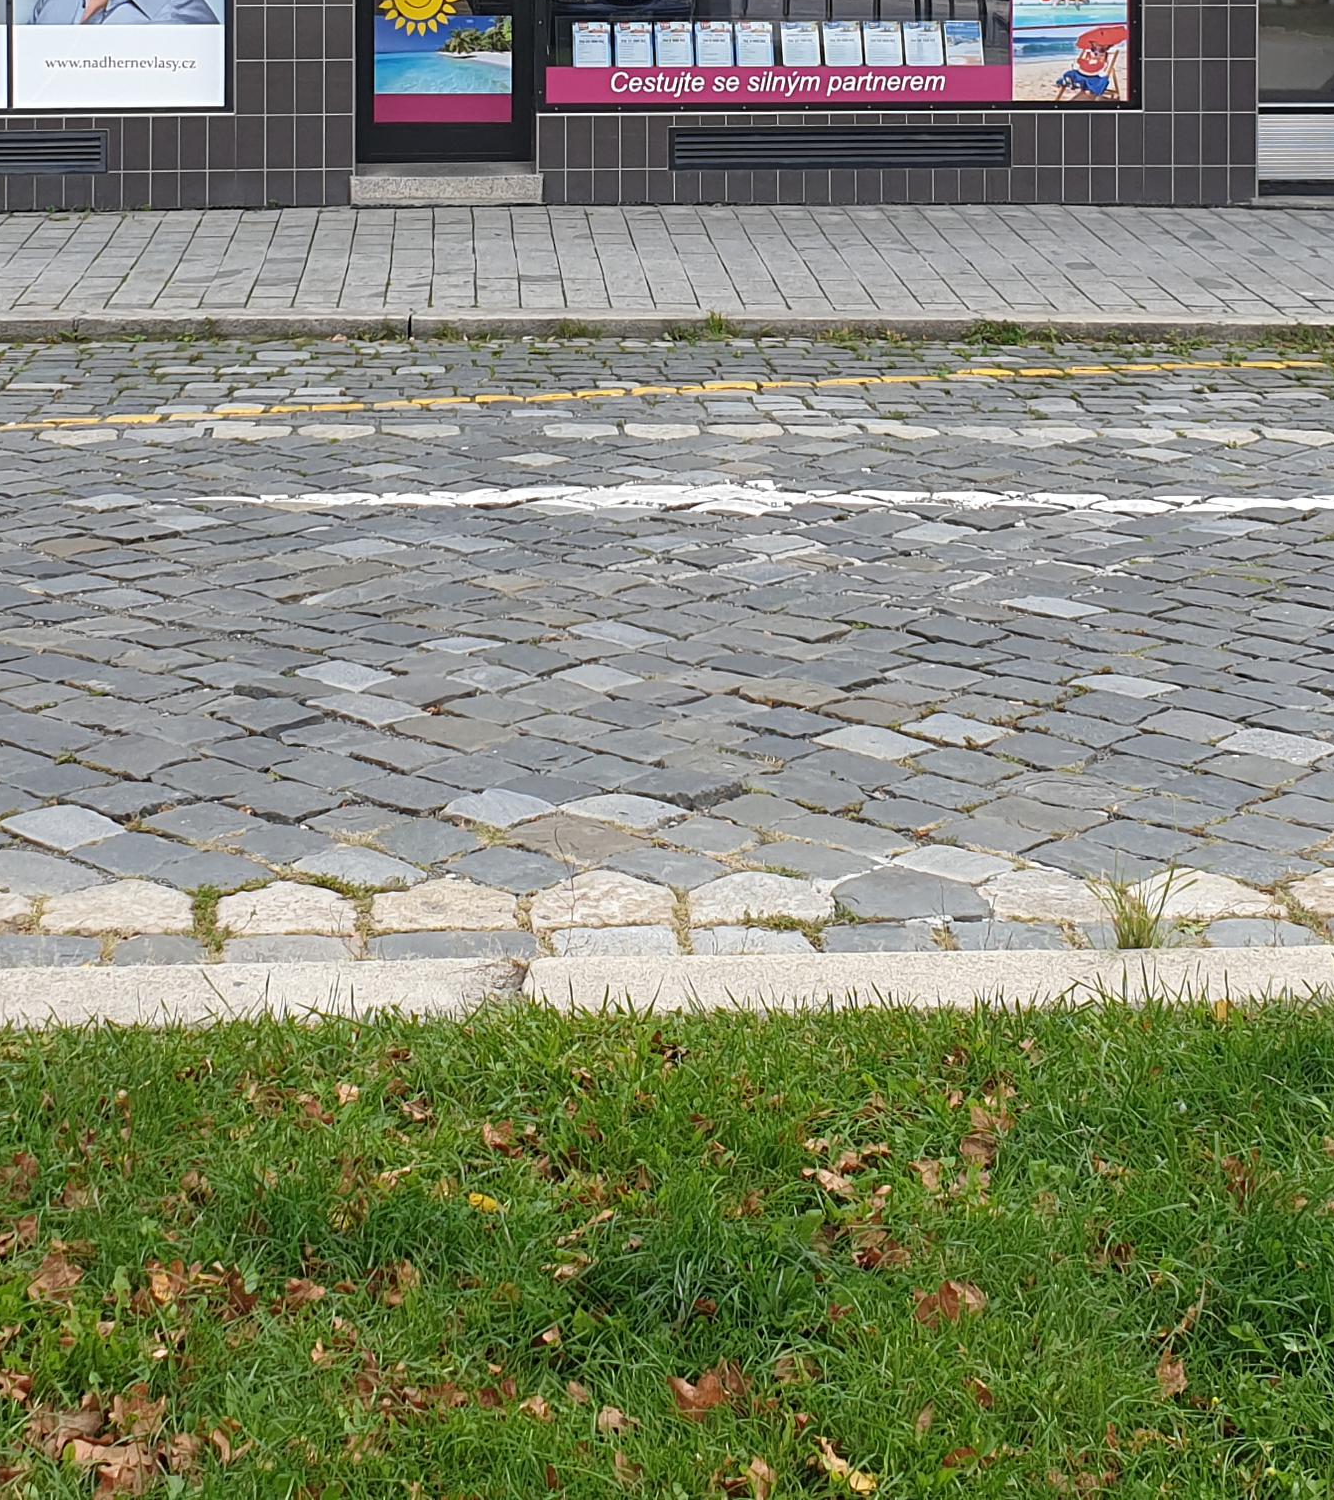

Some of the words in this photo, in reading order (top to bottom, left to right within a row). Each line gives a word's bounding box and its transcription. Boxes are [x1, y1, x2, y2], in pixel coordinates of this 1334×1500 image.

[45, 56, 197, 72] www.nadhernevlasy.cz
[610, 72, 705, 97] Cestujte
[712, 78, 740, 93] se
[747, 71, 821, 97] silným
[826, 71, 946, 96] partnerem
